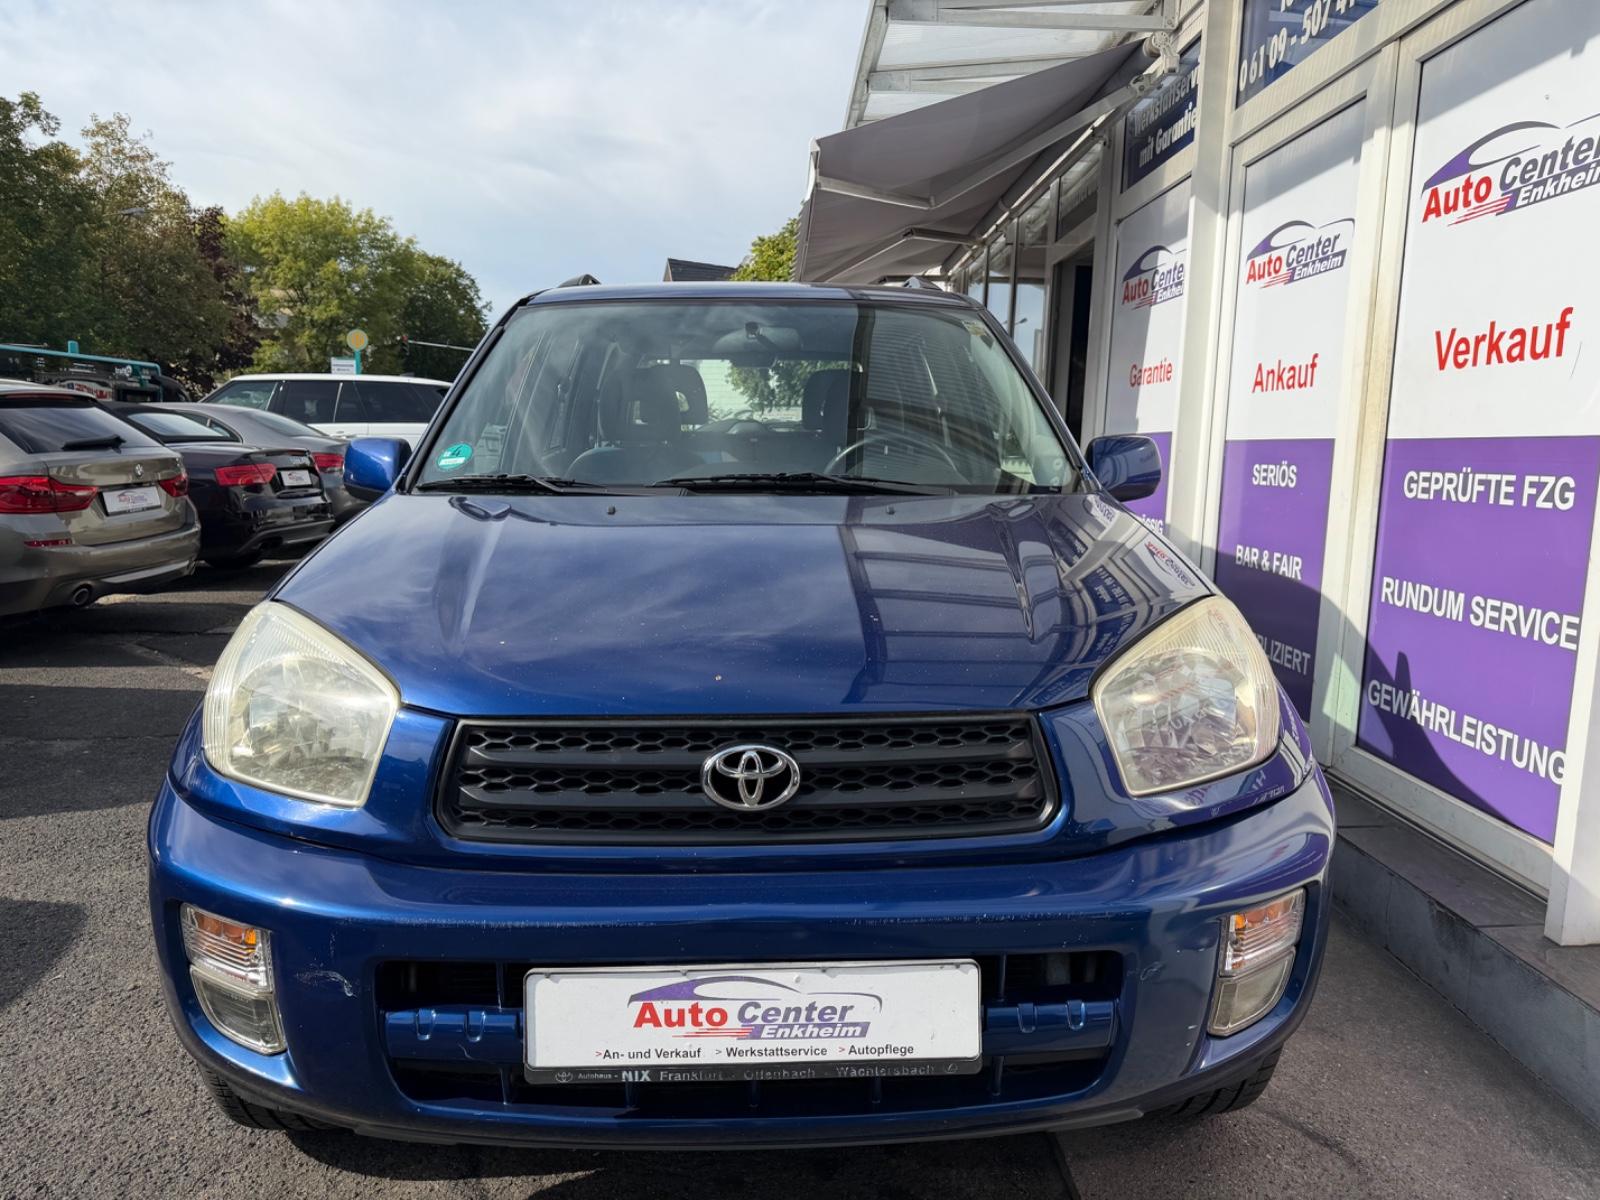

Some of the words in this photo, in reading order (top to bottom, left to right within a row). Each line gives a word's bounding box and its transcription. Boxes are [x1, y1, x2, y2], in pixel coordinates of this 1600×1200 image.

[1269, 27, 1287, 69] 09
[1156, 101, 1197, 154] Garantie
[1421, 174, 1493, 223] Auto
[1246, 253, 1283, 284] Auto
[1286, 233, 1341, 267] Center
[1293, 254, 1342, 281] Enkheim
[1122, 276, 1149, 304] Auto
[1151, 262, 1184, 291] Cente
[1157, 282, 1184, 302] Enkhei
[1435, 306, 1574, 371] Verkauf
[1129, 356, 1173, 388] Garantie
[1252, 353, 1319, 393] Ankauf
[1252, 461, 1297, 488] SERIÖS
[1403, 467, 1516, 506] GEPRÜFTE
[1522, 475, 1575, 511] FZG
[1235, 545, 1259, 569] BAR
[1261, 550, 1271, 572] &
[1273, 553, 1303, 580] FAIR
[1381, 576, 1465, 622] RUNDUM
[1469, 596, 1580, 651] SERVICE
[1367, 679, 1567, 785] GEWÄHRLEISTUNG
[633, 1002, 728, 1028] Auto
[737, 1001, 854, 1024] Center
[760, 1023, 862, 1039] Enkheim
[603, 1050, 625, 1060] An-
[628, 1049, 651, 1060] und
[655, 1048, 701, 1059] Verkauf
[725, 1045, 828, 1058] Werkstattservice
[848, 1043, 914, 1056] Autopflege
[621, 1070, 651, 1082] NIX
